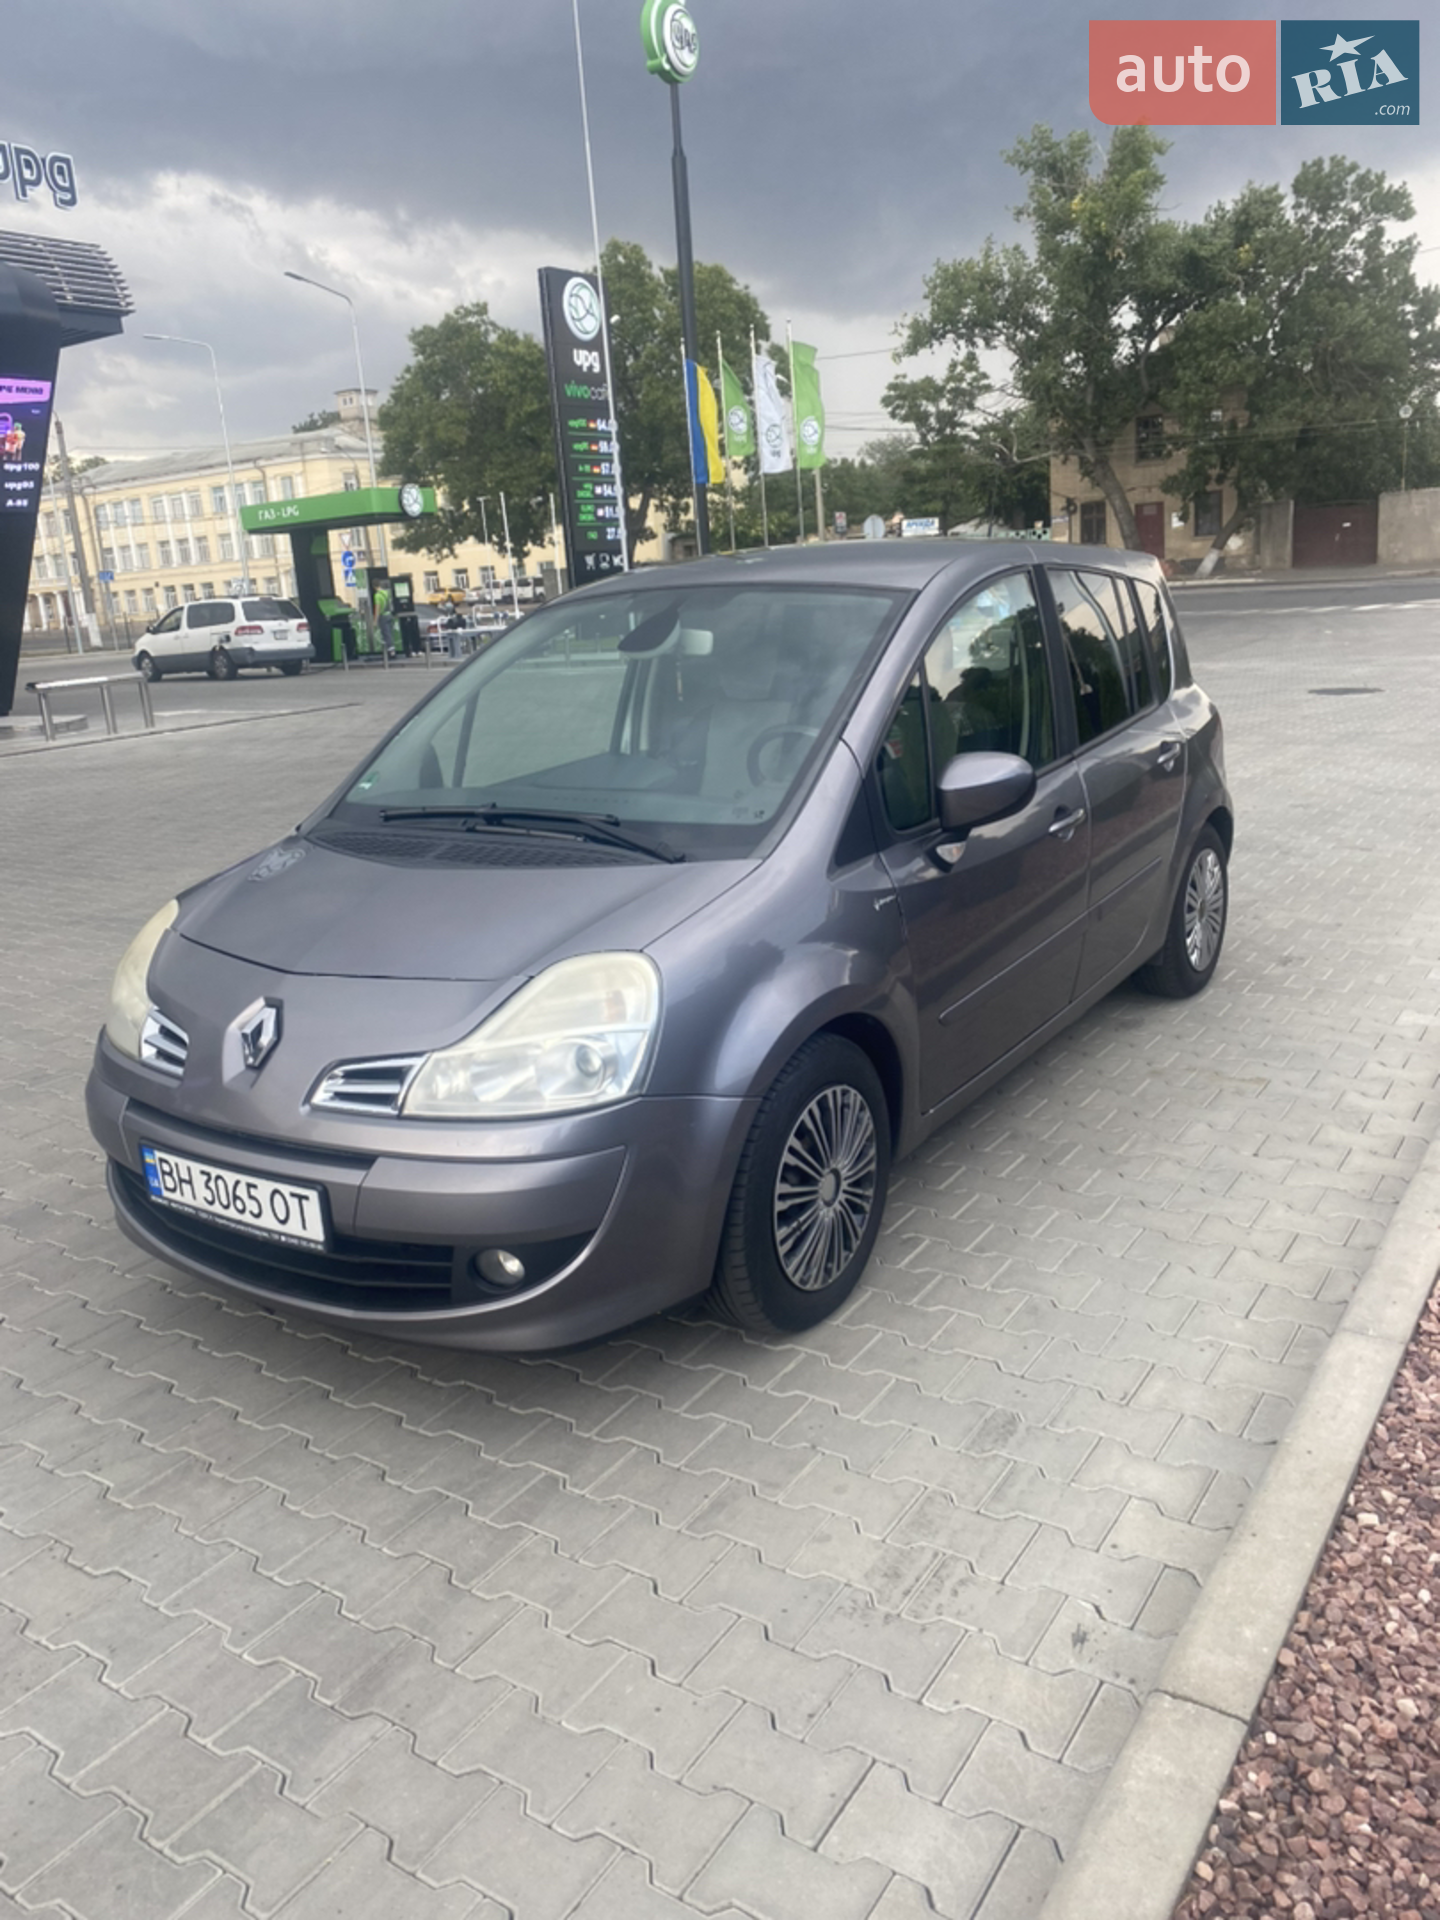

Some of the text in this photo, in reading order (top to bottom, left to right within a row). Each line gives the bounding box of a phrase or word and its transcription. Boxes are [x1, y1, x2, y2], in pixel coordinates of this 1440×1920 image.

[573, 349, 600, 373] upg
[158, 1157, 196, 1201] BH
[200, 1170, 263, 1219] 3065
[270, 1188, 310, 1231] OT
